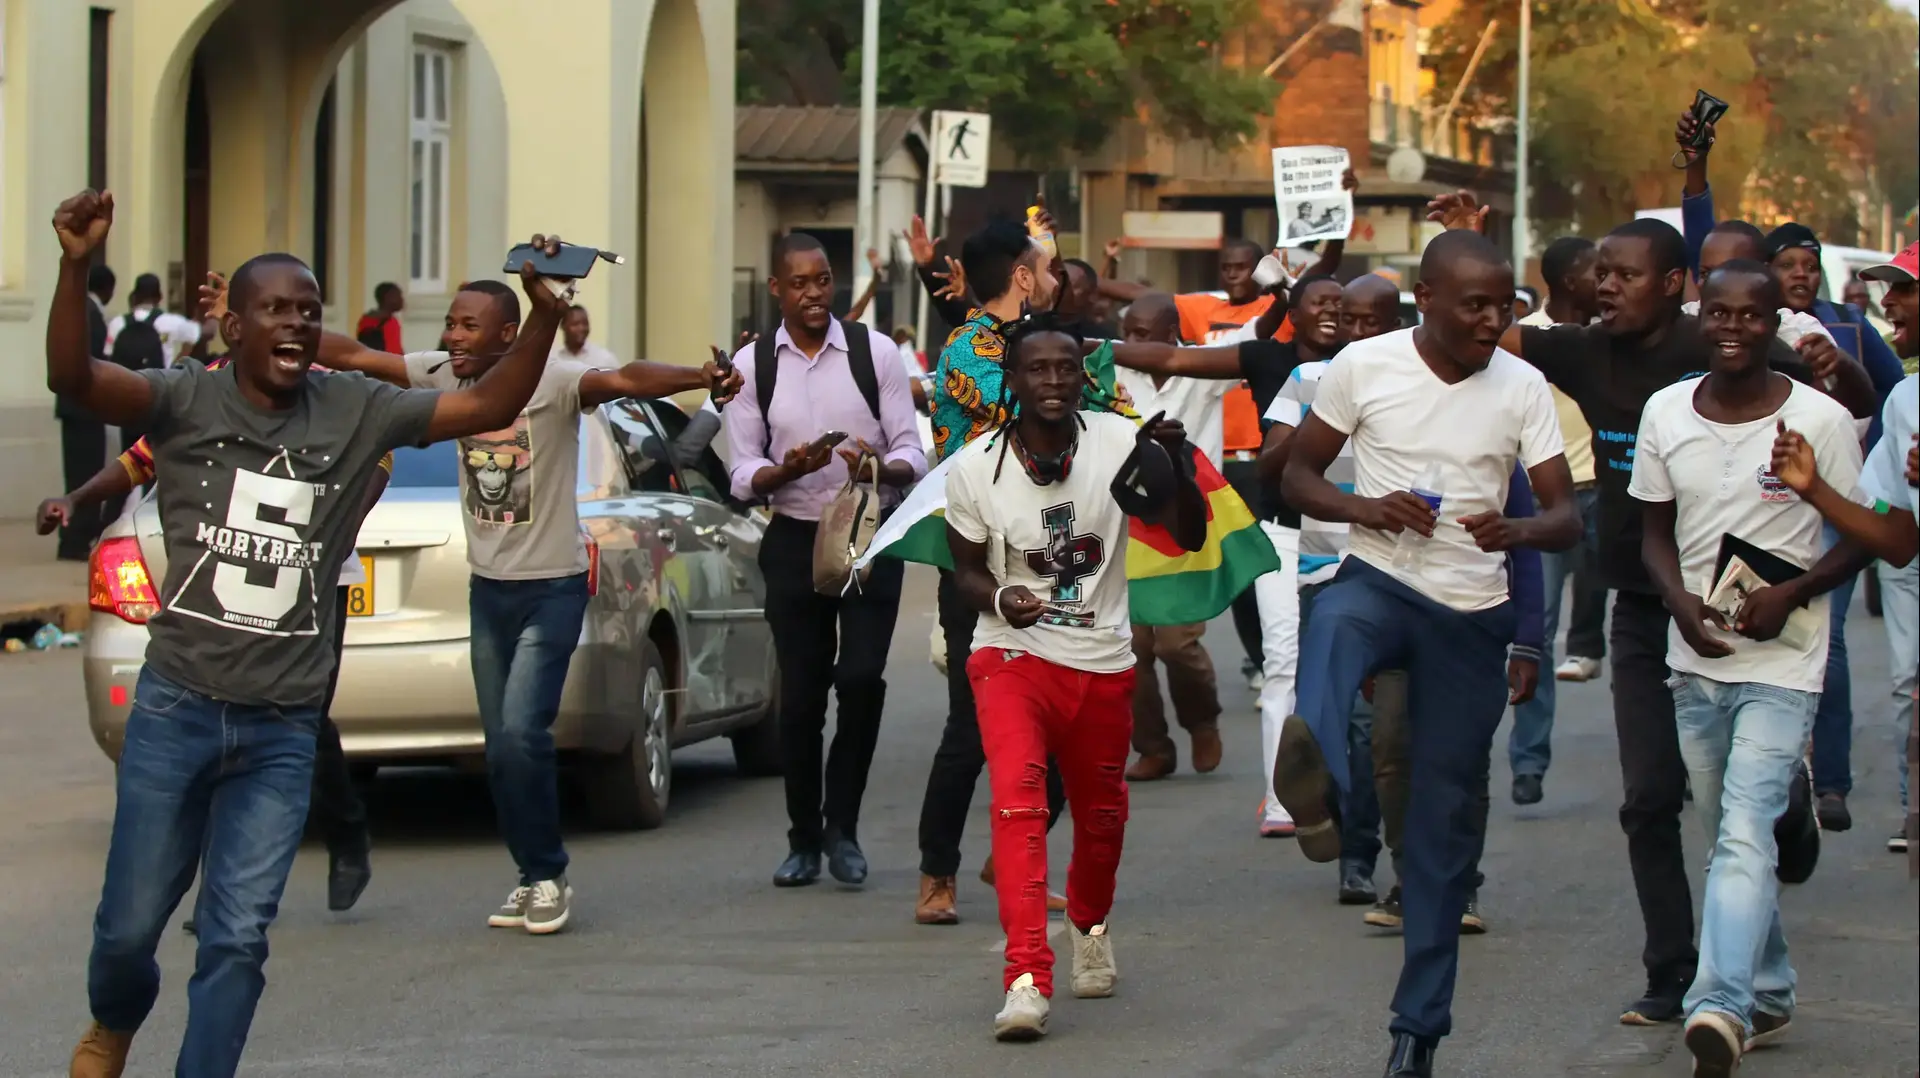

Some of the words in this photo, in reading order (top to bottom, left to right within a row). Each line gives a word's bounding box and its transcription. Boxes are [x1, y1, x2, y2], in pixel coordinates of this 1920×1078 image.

[1294, 184, 1309, 194] the
[1607, 430, 1627, 442] Right
[314, 483, 326, 496] TH
[196, 522, 323, 562] MOBYBEST
[350, 587, 365, 613] 8
[223, 612, 278, 630] ANNIVERSARY
